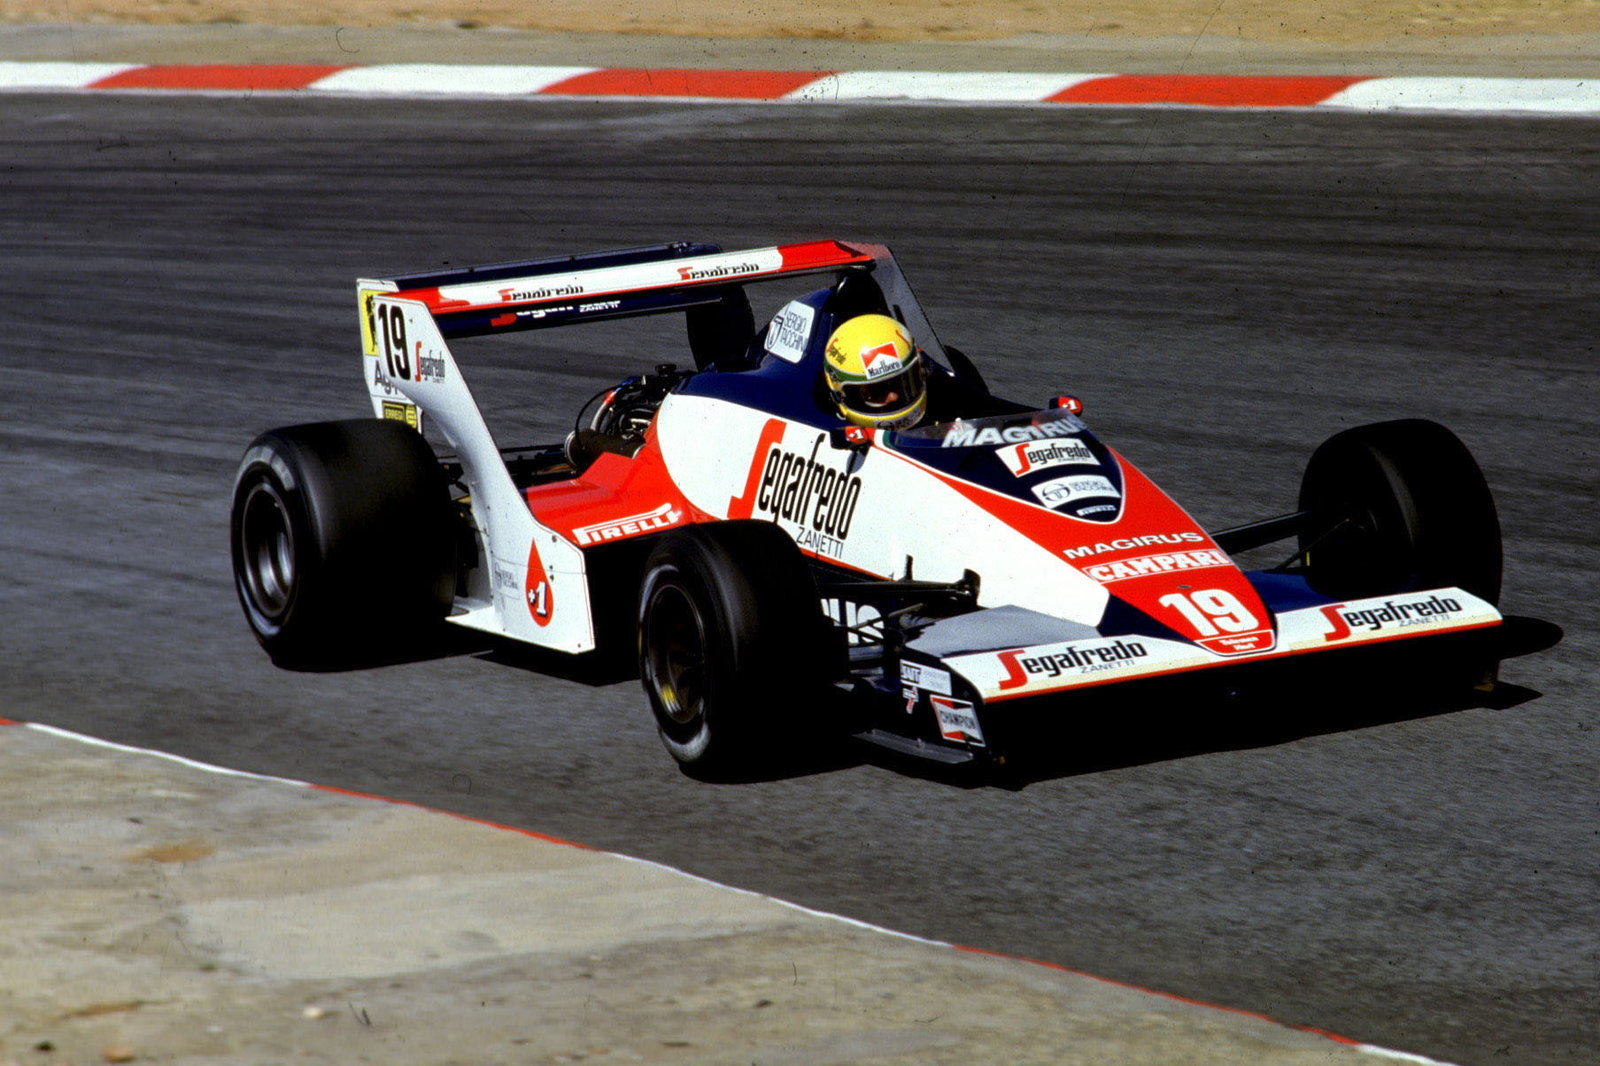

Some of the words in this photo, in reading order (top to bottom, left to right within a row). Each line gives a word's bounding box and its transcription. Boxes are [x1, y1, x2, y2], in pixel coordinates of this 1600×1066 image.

[377, 303, 411, 381] 19
[868, 360, 900, 376] Marlboro
[1014, 442, 1092, 476] Segafredo
[726, 418, 862, 540] Segafredo
[796, 526, 844, 559] ZANETTI
[1062, 532, 1205, 560] MAGIRUS
[1089, 549, 1231, 582] CAMPARI
[1158, 588, 1260, 637] 19
[1319, 596, 1462, 642] Segafredo
[1399, 614, 1450, 627] ZANETTI
[997, 641, 1147, 690] Segafredo
[1080, 659, 1136, 674] ZANETTI
